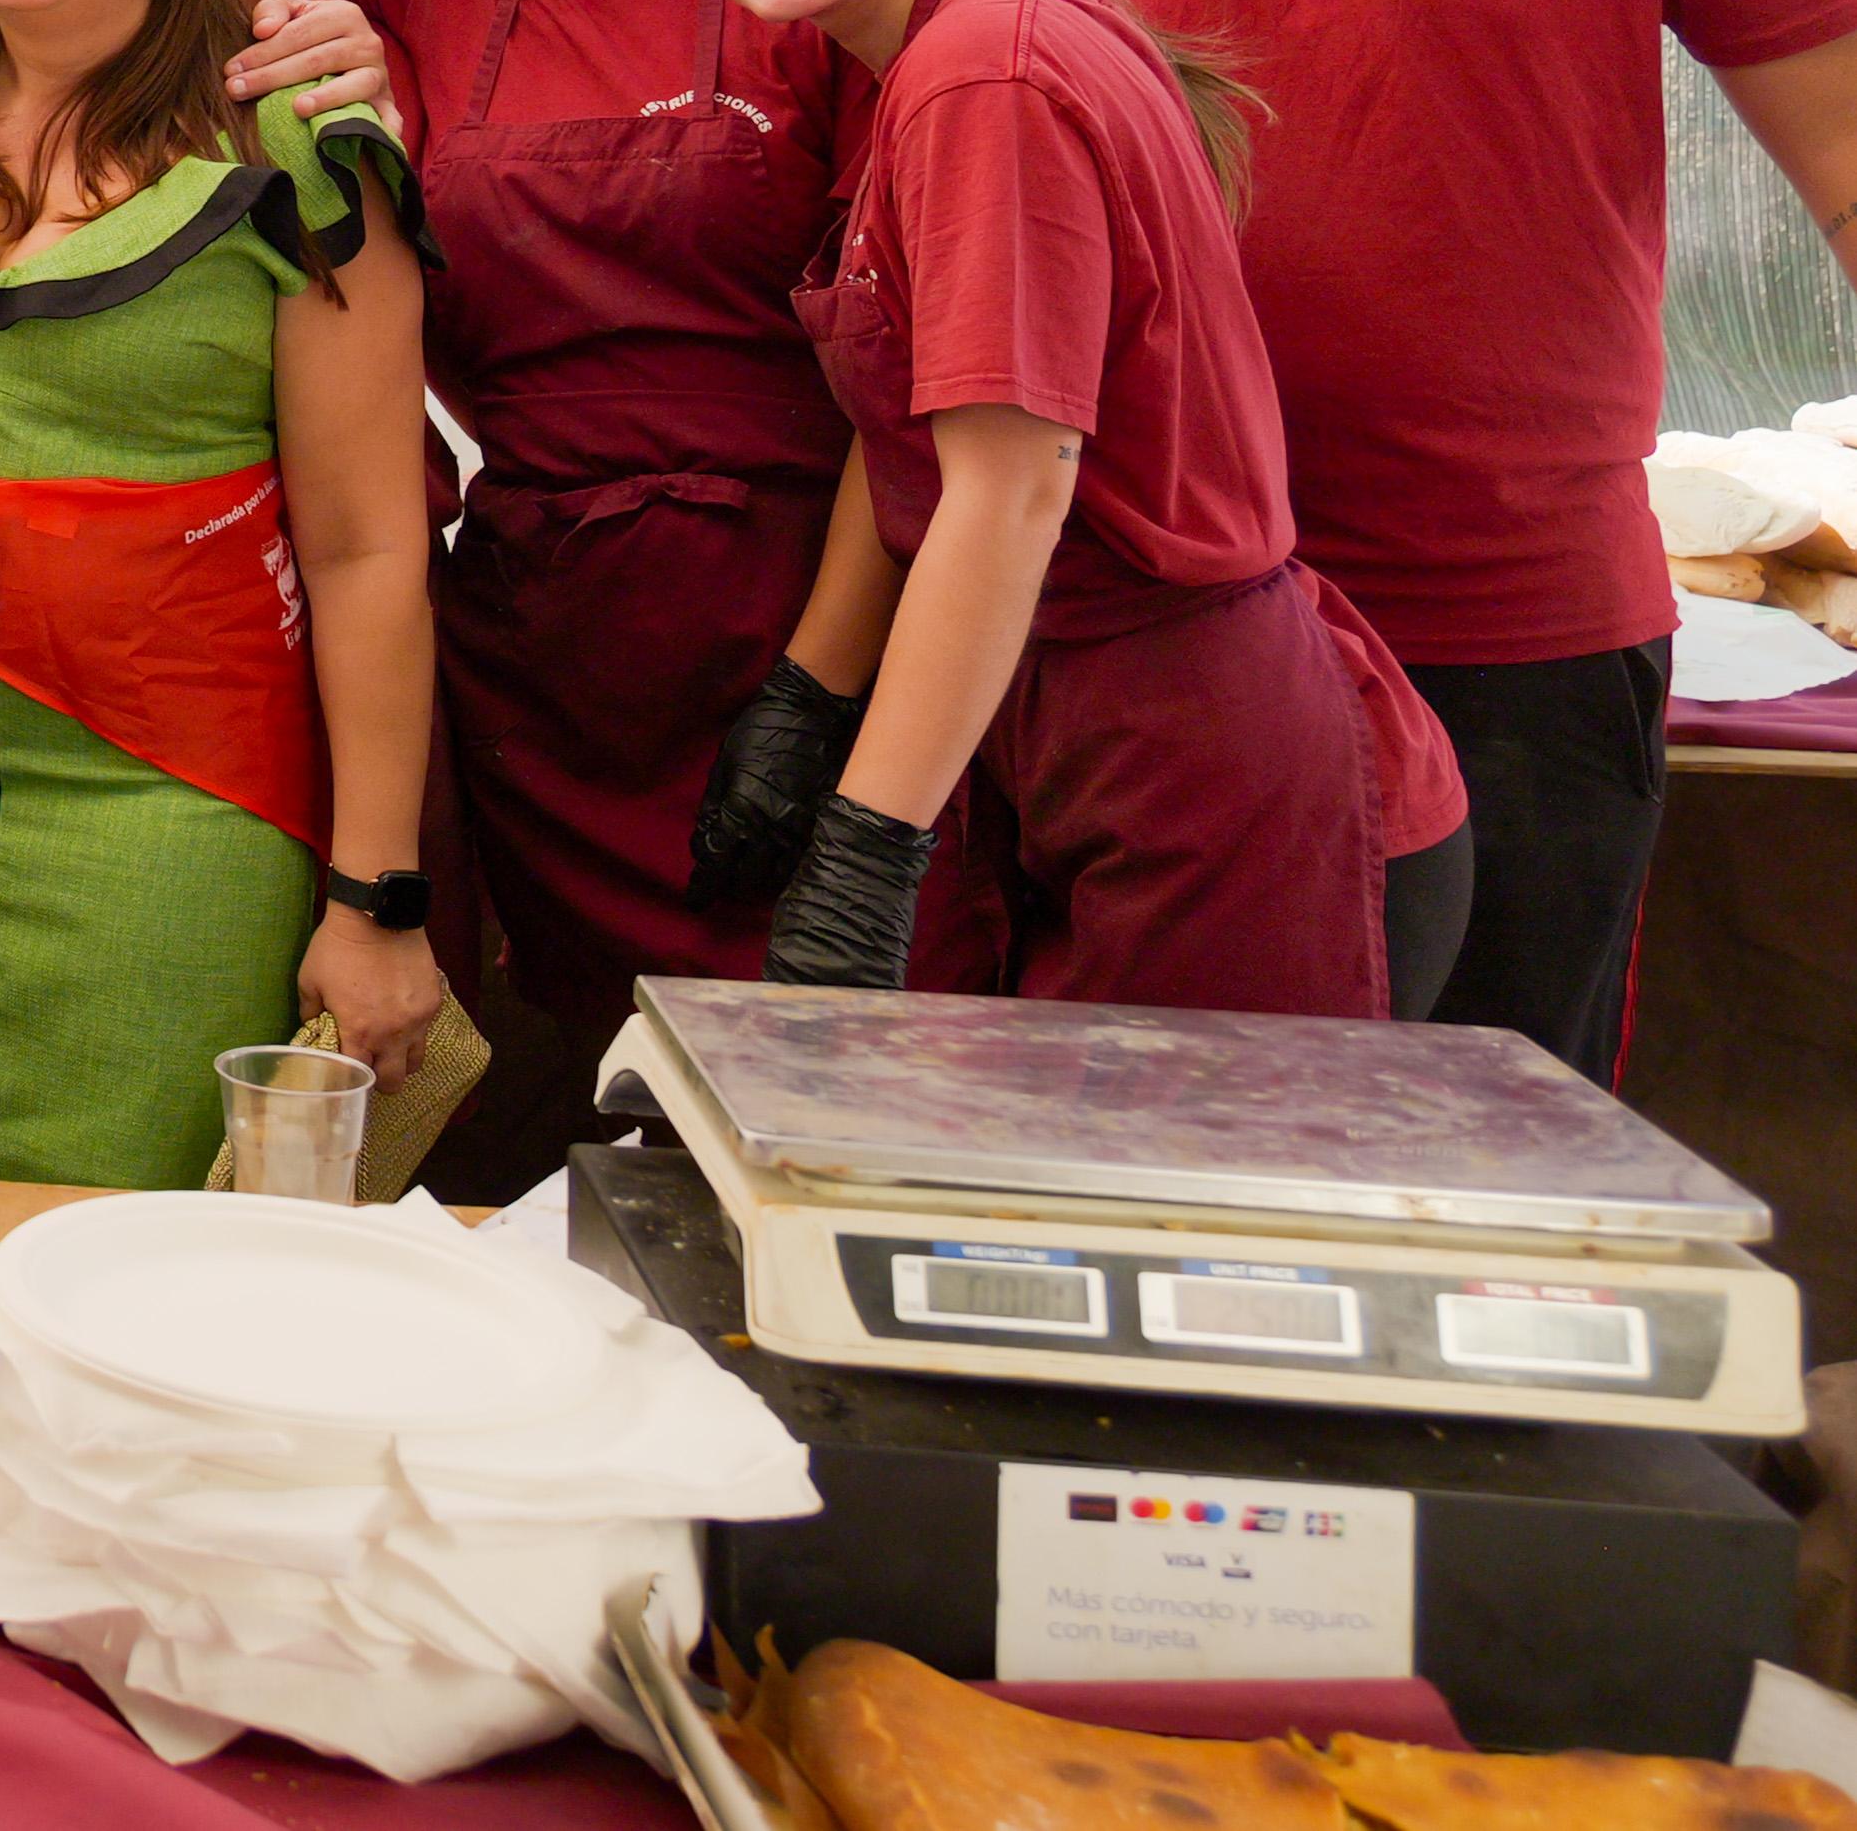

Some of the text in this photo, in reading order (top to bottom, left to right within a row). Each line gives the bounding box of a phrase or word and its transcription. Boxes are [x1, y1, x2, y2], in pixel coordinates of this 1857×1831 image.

[184, 505, 246, 544] Declarada
[243, 493, 260, 515] por
[1048, 1585, 1103, 1611] Más
[1110, 1587, 1234, 1621] cómodo
[1245, 1605, 1260, 1628] y
[1048, 1621, 1101, 1642] con
